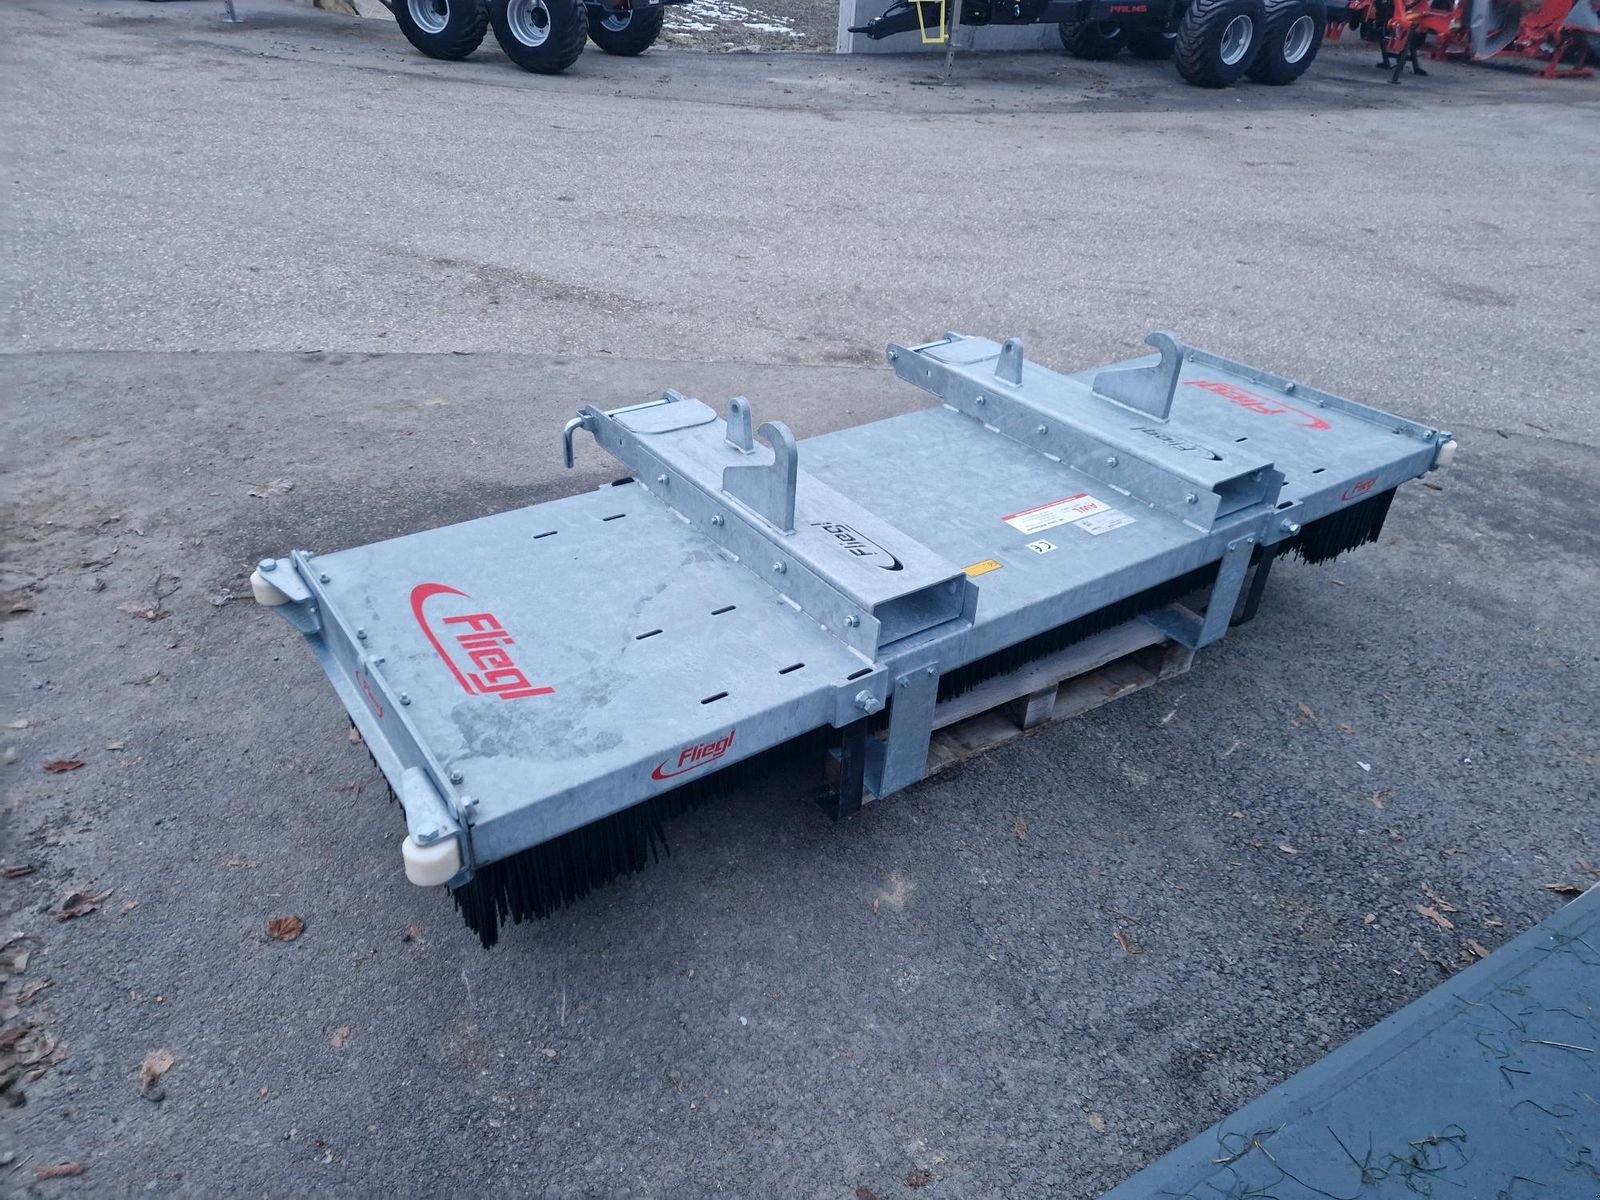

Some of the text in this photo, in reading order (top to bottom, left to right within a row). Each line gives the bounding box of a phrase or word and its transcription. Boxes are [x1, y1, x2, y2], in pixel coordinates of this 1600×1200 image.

[810, 522, 878, 556] Fliegl
[442, 613, 555, 700] Fliegl
[678, 728, 736, 768] Fliegl
